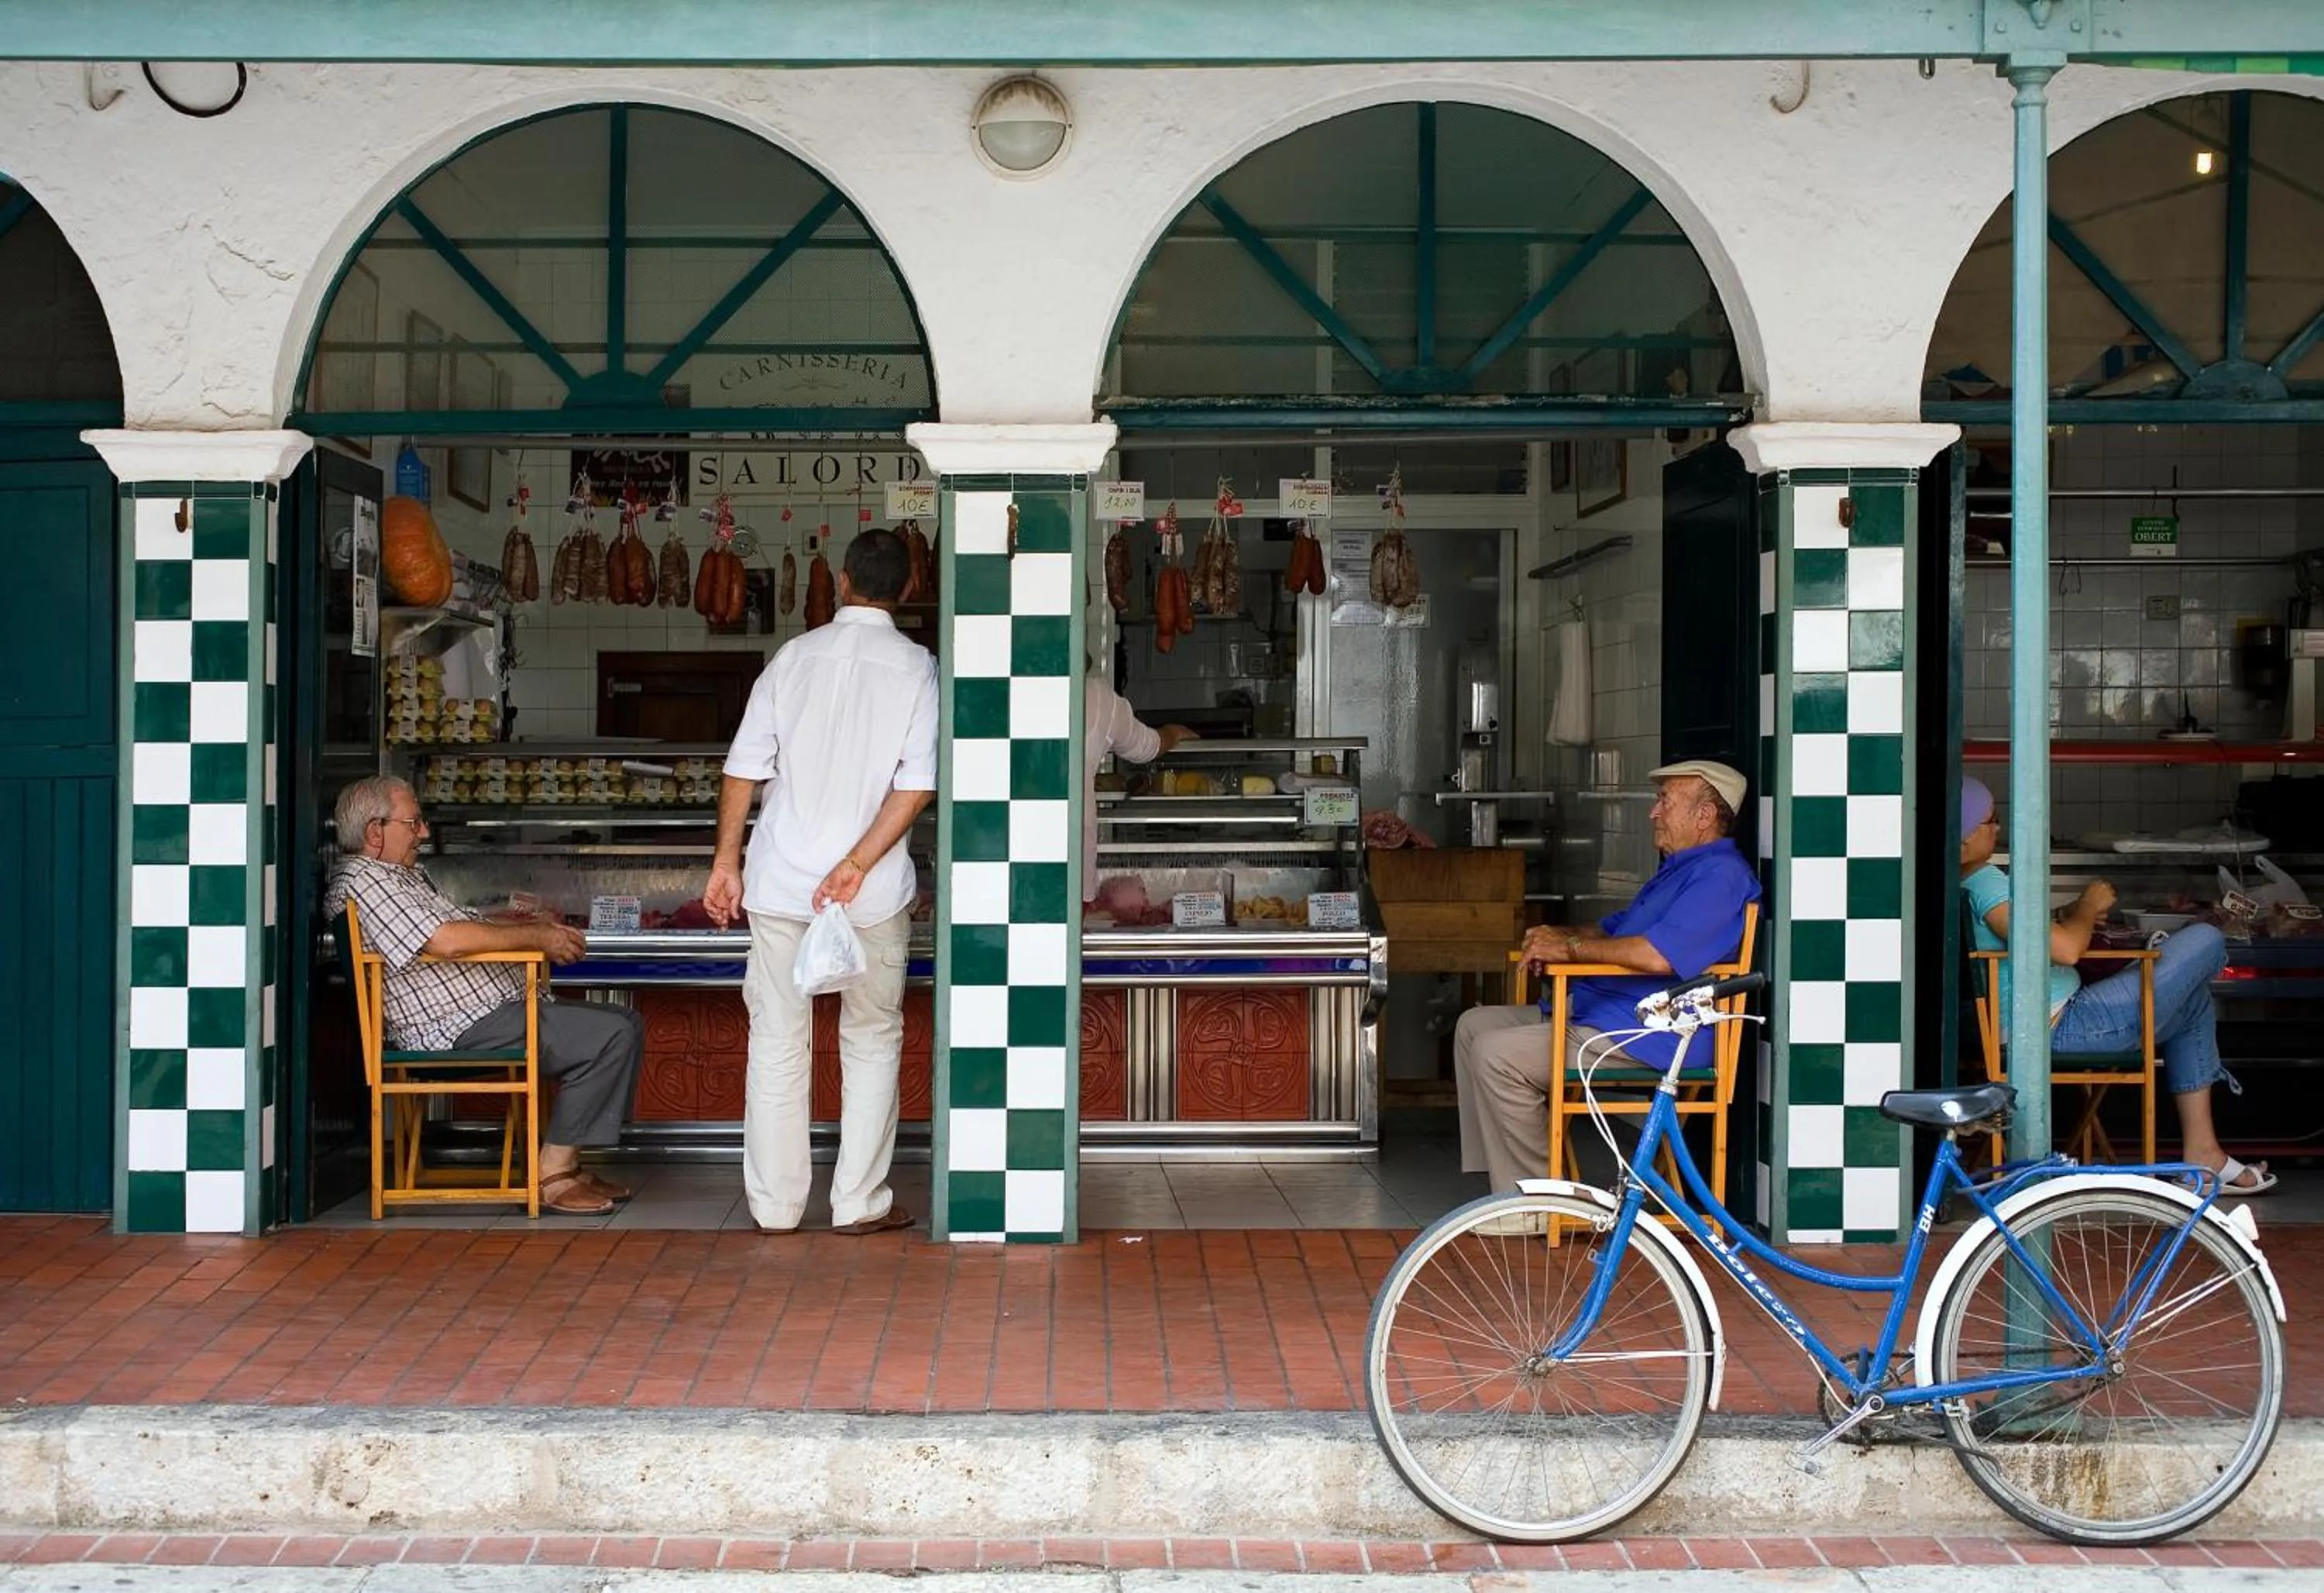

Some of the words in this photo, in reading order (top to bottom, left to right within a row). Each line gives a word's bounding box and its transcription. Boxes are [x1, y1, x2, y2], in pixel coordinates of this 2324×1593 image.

[719, 353, 907, 390] CARNISSERIA
[699, 455, 921, 485] SALORD
[2134, 532, 2171, 542] OBERT
[1917, 1203, 1936, 1233] BH
